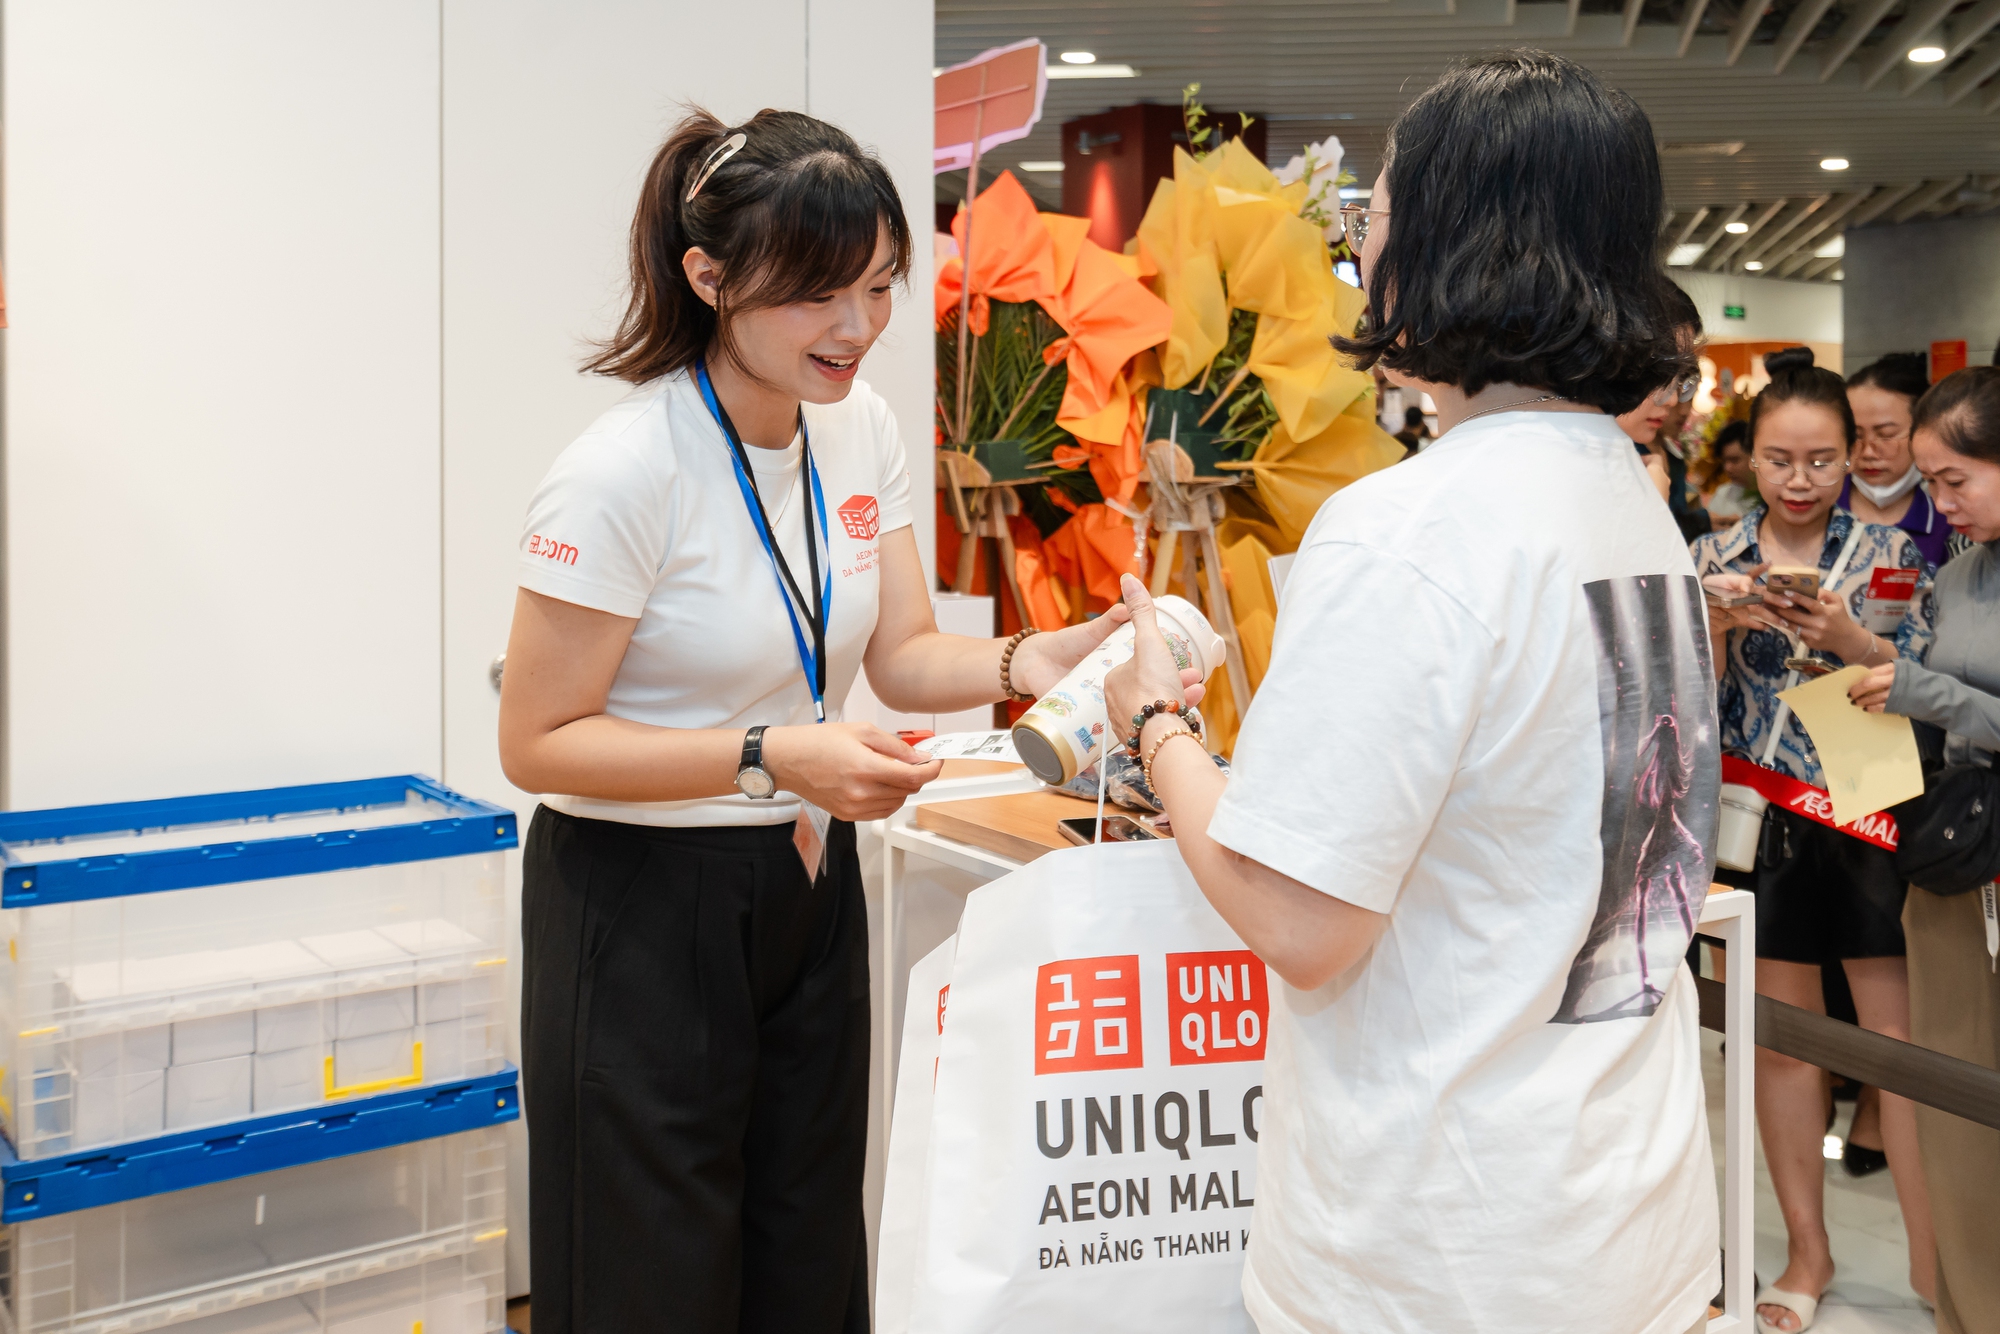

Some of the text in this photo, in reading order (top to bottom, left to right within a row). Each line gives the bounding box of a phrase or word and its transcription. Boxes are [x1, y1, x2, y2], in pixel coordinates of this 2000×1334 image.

[864, 504, 878, 523] UNI
[855, 549, 873, 561] AEON
[1852, 814, 1898, 847] MAL
[1047, 970, 1127, 1012] ユニ
[1178, 964, 1252, 1004] UNI
[1180, 1009, 1261, 1057] QLO
[1038, 1169, 1255, 1226] AEON MAL
[1039, 1239, 1071, 1270] ĐÀ
[1081, 1232, 1144, 1266] NẴNG
[1153, 1230, 1230, 1259] THANH
